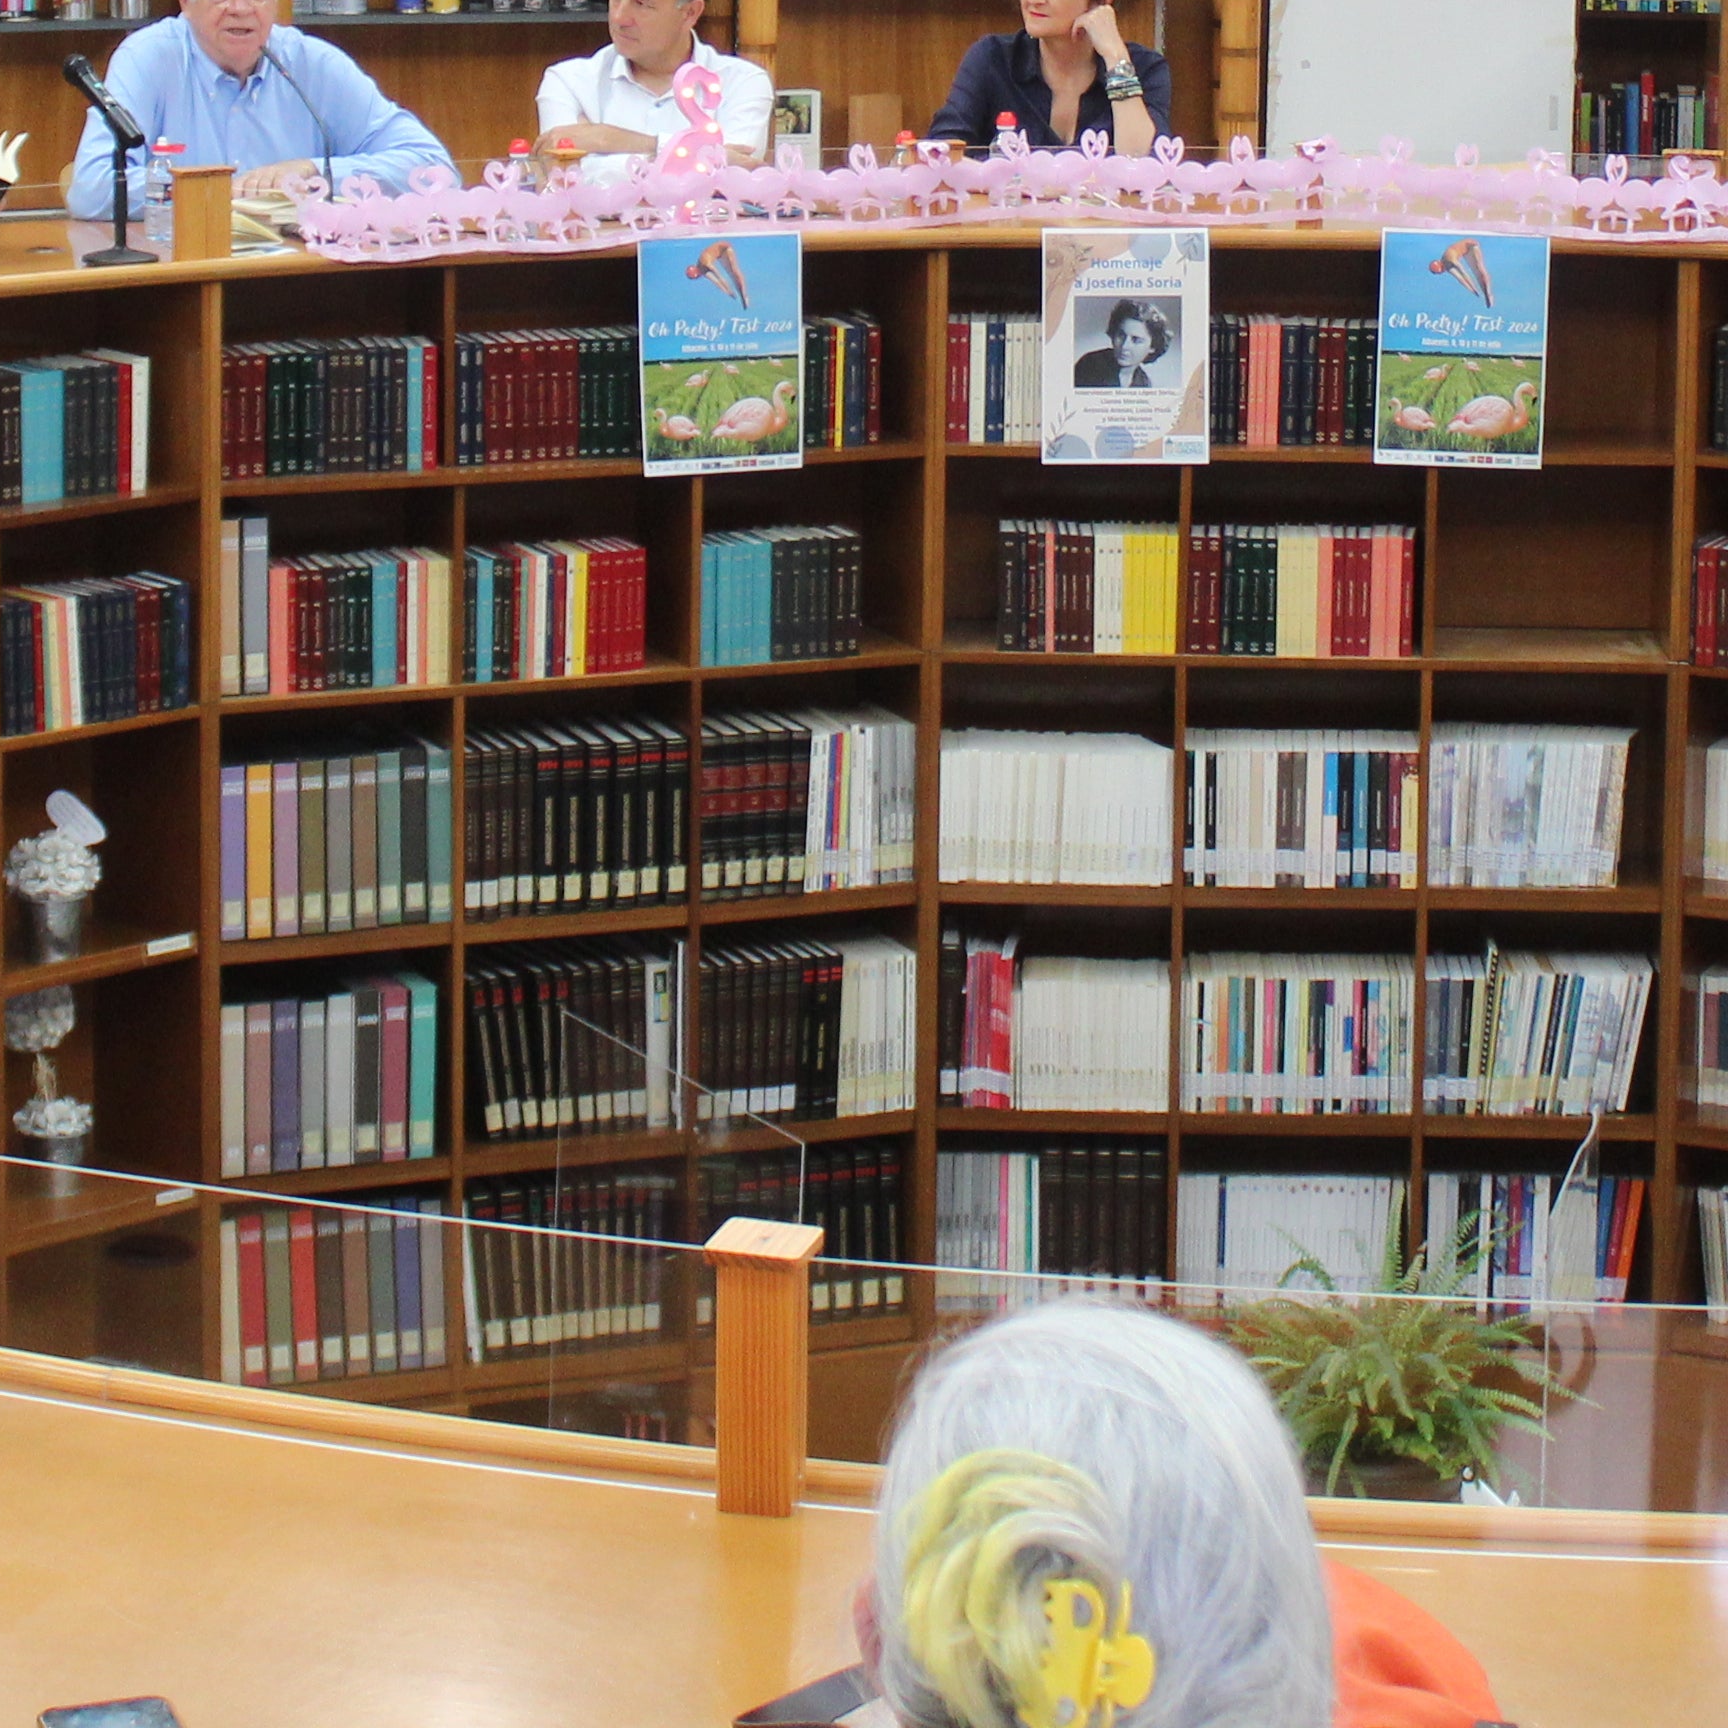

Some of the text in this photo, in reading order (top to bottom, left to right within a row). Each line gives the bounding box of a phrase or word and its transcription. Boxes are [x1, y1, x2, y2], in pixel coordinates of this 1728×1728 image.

[1091, 258, 1163, 272] Homenaje
[1074, 276, 1182, 291] a Josefina Soria
[648, 317, 794, 342] Oh Poetry! Fest 2024
[1388, 311, 1539, 337] Oh Poetry! Fest 2024
